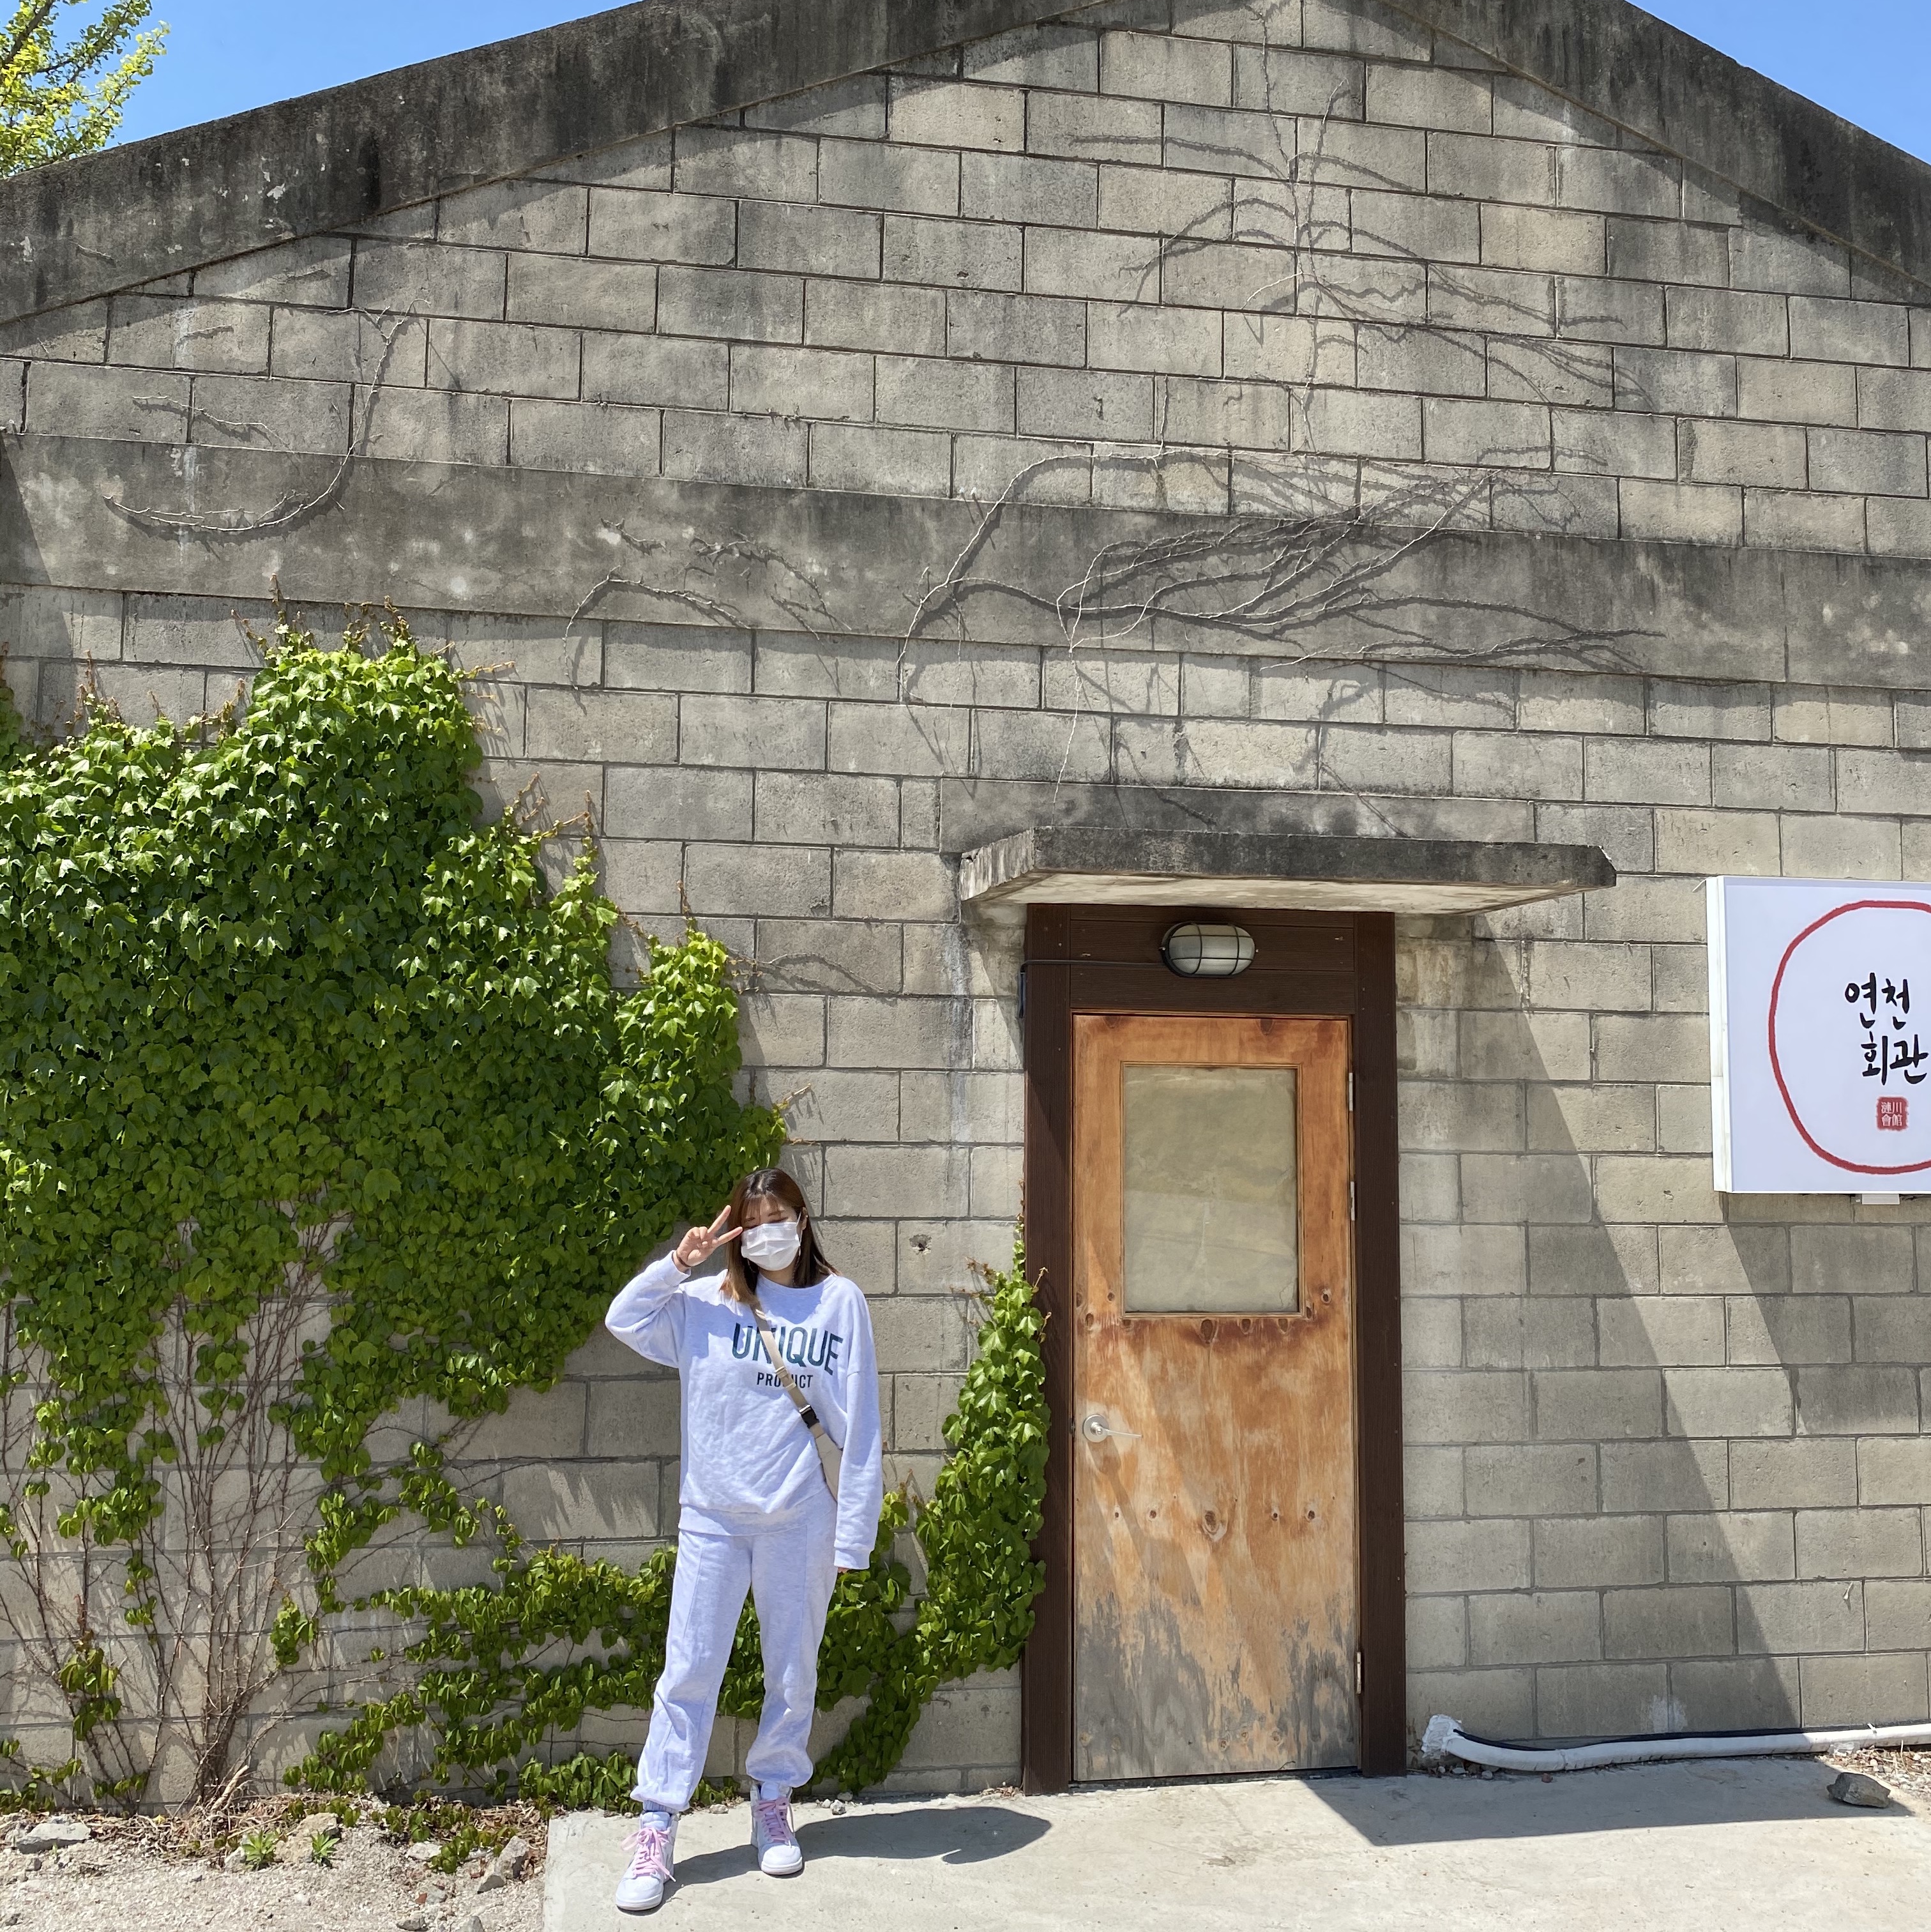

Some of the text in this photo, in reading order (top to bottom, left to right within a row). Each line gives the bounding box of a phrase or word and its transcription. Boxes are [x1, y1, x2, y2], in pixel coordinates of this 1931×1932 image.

[1844, 972, 1910, 1030] 연천
[1860, 1031, 1929, 1086] 회관
[732, 1322, 844, 1376] UNIQUE
[756, 1371, 814, 1388] PROUCT
